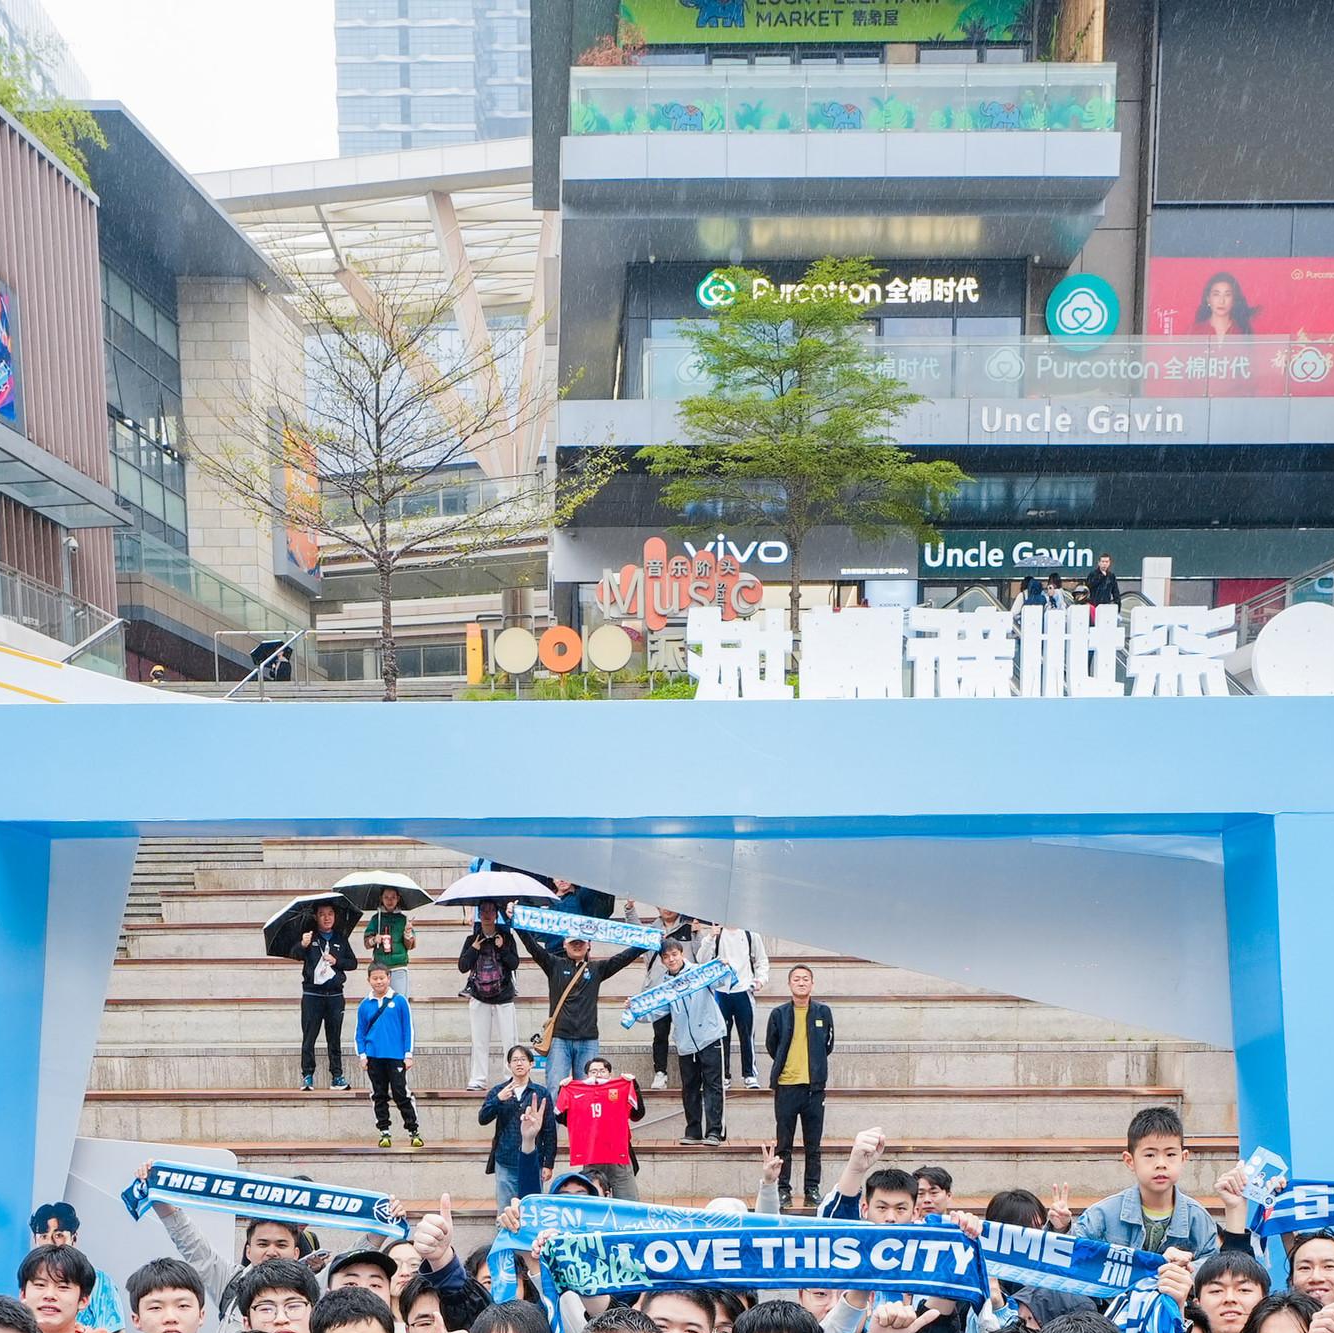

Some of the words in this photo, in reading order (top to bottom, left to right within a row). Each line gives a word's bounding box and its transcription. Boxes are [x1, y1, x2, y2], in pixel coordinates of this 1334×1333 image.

[755, 10, 844, 27] MARKET
[885, 277, 980, 304] 全棉时代
[1037, 355, 1159, 380] Purcotton
[1163, 356, 1252, 380] 全棉时代
[981, 405, 1072, 433] Uncle
[1087, 405, 1184, 435] Gavin
[683, 534, 790, 564] vivo
[923, 541, 1004, 569] Uncle
[590, 1102, 603, 1118] 19
[156, 1169, 207, 1192] THIS
[210, 1179, 238, 1196] IS
[239, 1184, 311, 1207] CURVA
[315, 1194, 364, 1213] SUD
[753, 1237, 862, 1270] THIS
[869, 1238, 977, 1276] CITY
